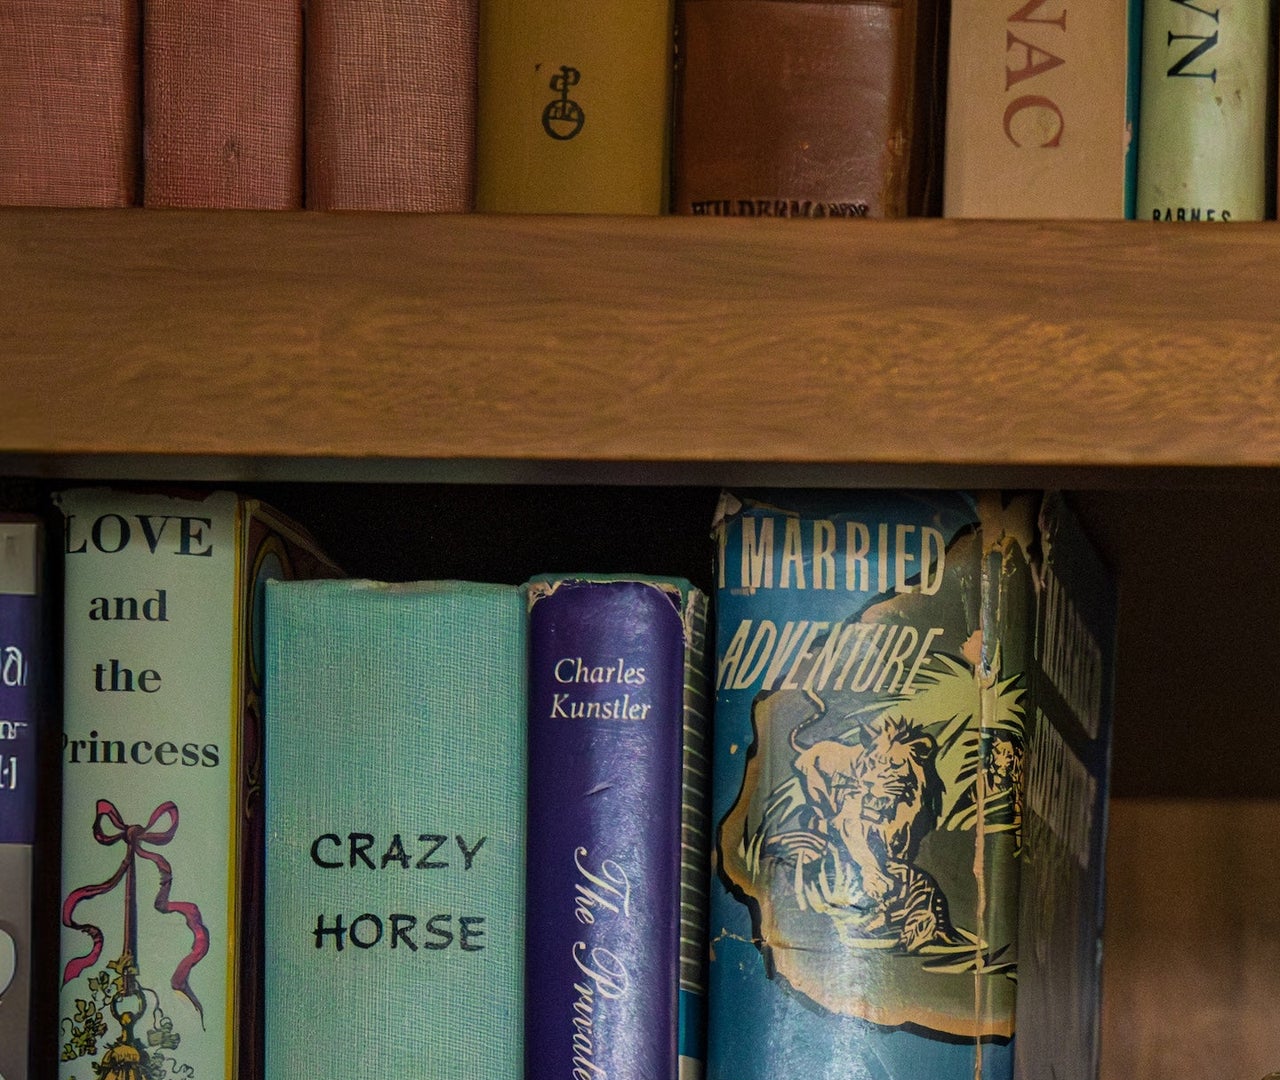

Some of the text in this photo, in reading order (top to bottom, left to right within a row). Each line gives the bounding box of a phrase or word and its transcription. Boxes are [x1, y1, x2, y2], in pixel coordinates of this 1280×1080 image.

[1152, 208, 1232, 222] BARNES
[64, 513, 213, 557] LOVE
[740, 516, 947, 596] MARRIED
[88, 589, 169, 622] and
[92, 658, 162, 693] the
[554, 657, 646, 685] Charles
[716, 619, 945, 695] ADVENTURE
[550, 693, 652, 720] Kunstler
[310, 832, 488, 872] CRAZY
[574, 846, 631, 926] The
[312, 912, 486, 952] HORSE
